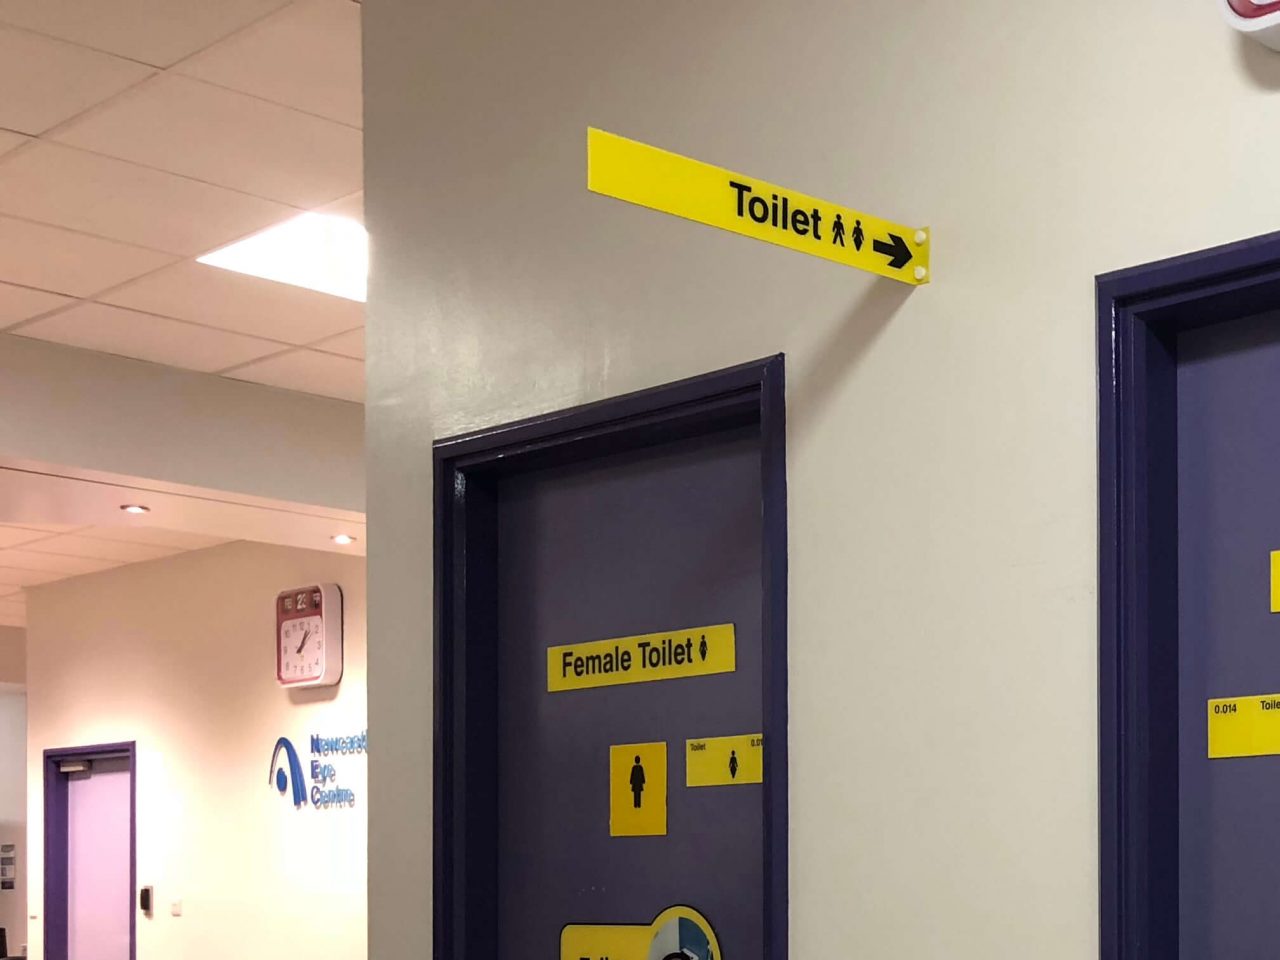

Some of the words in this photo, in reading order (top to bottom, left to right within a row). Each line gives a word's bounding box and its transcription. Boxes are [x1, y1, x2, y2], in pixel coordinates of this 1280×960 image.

[729, 180, 822, 241] Toilet
[562, 645, 632, 678] Female
[637, 637, 693, 669] Toilet
[1213, 703, 1237, 714] 0.014
[690, 743, 706, 752] Toilet
[311, 760, 336, 785] Eye
[311, 785, 355, 807] Centre
